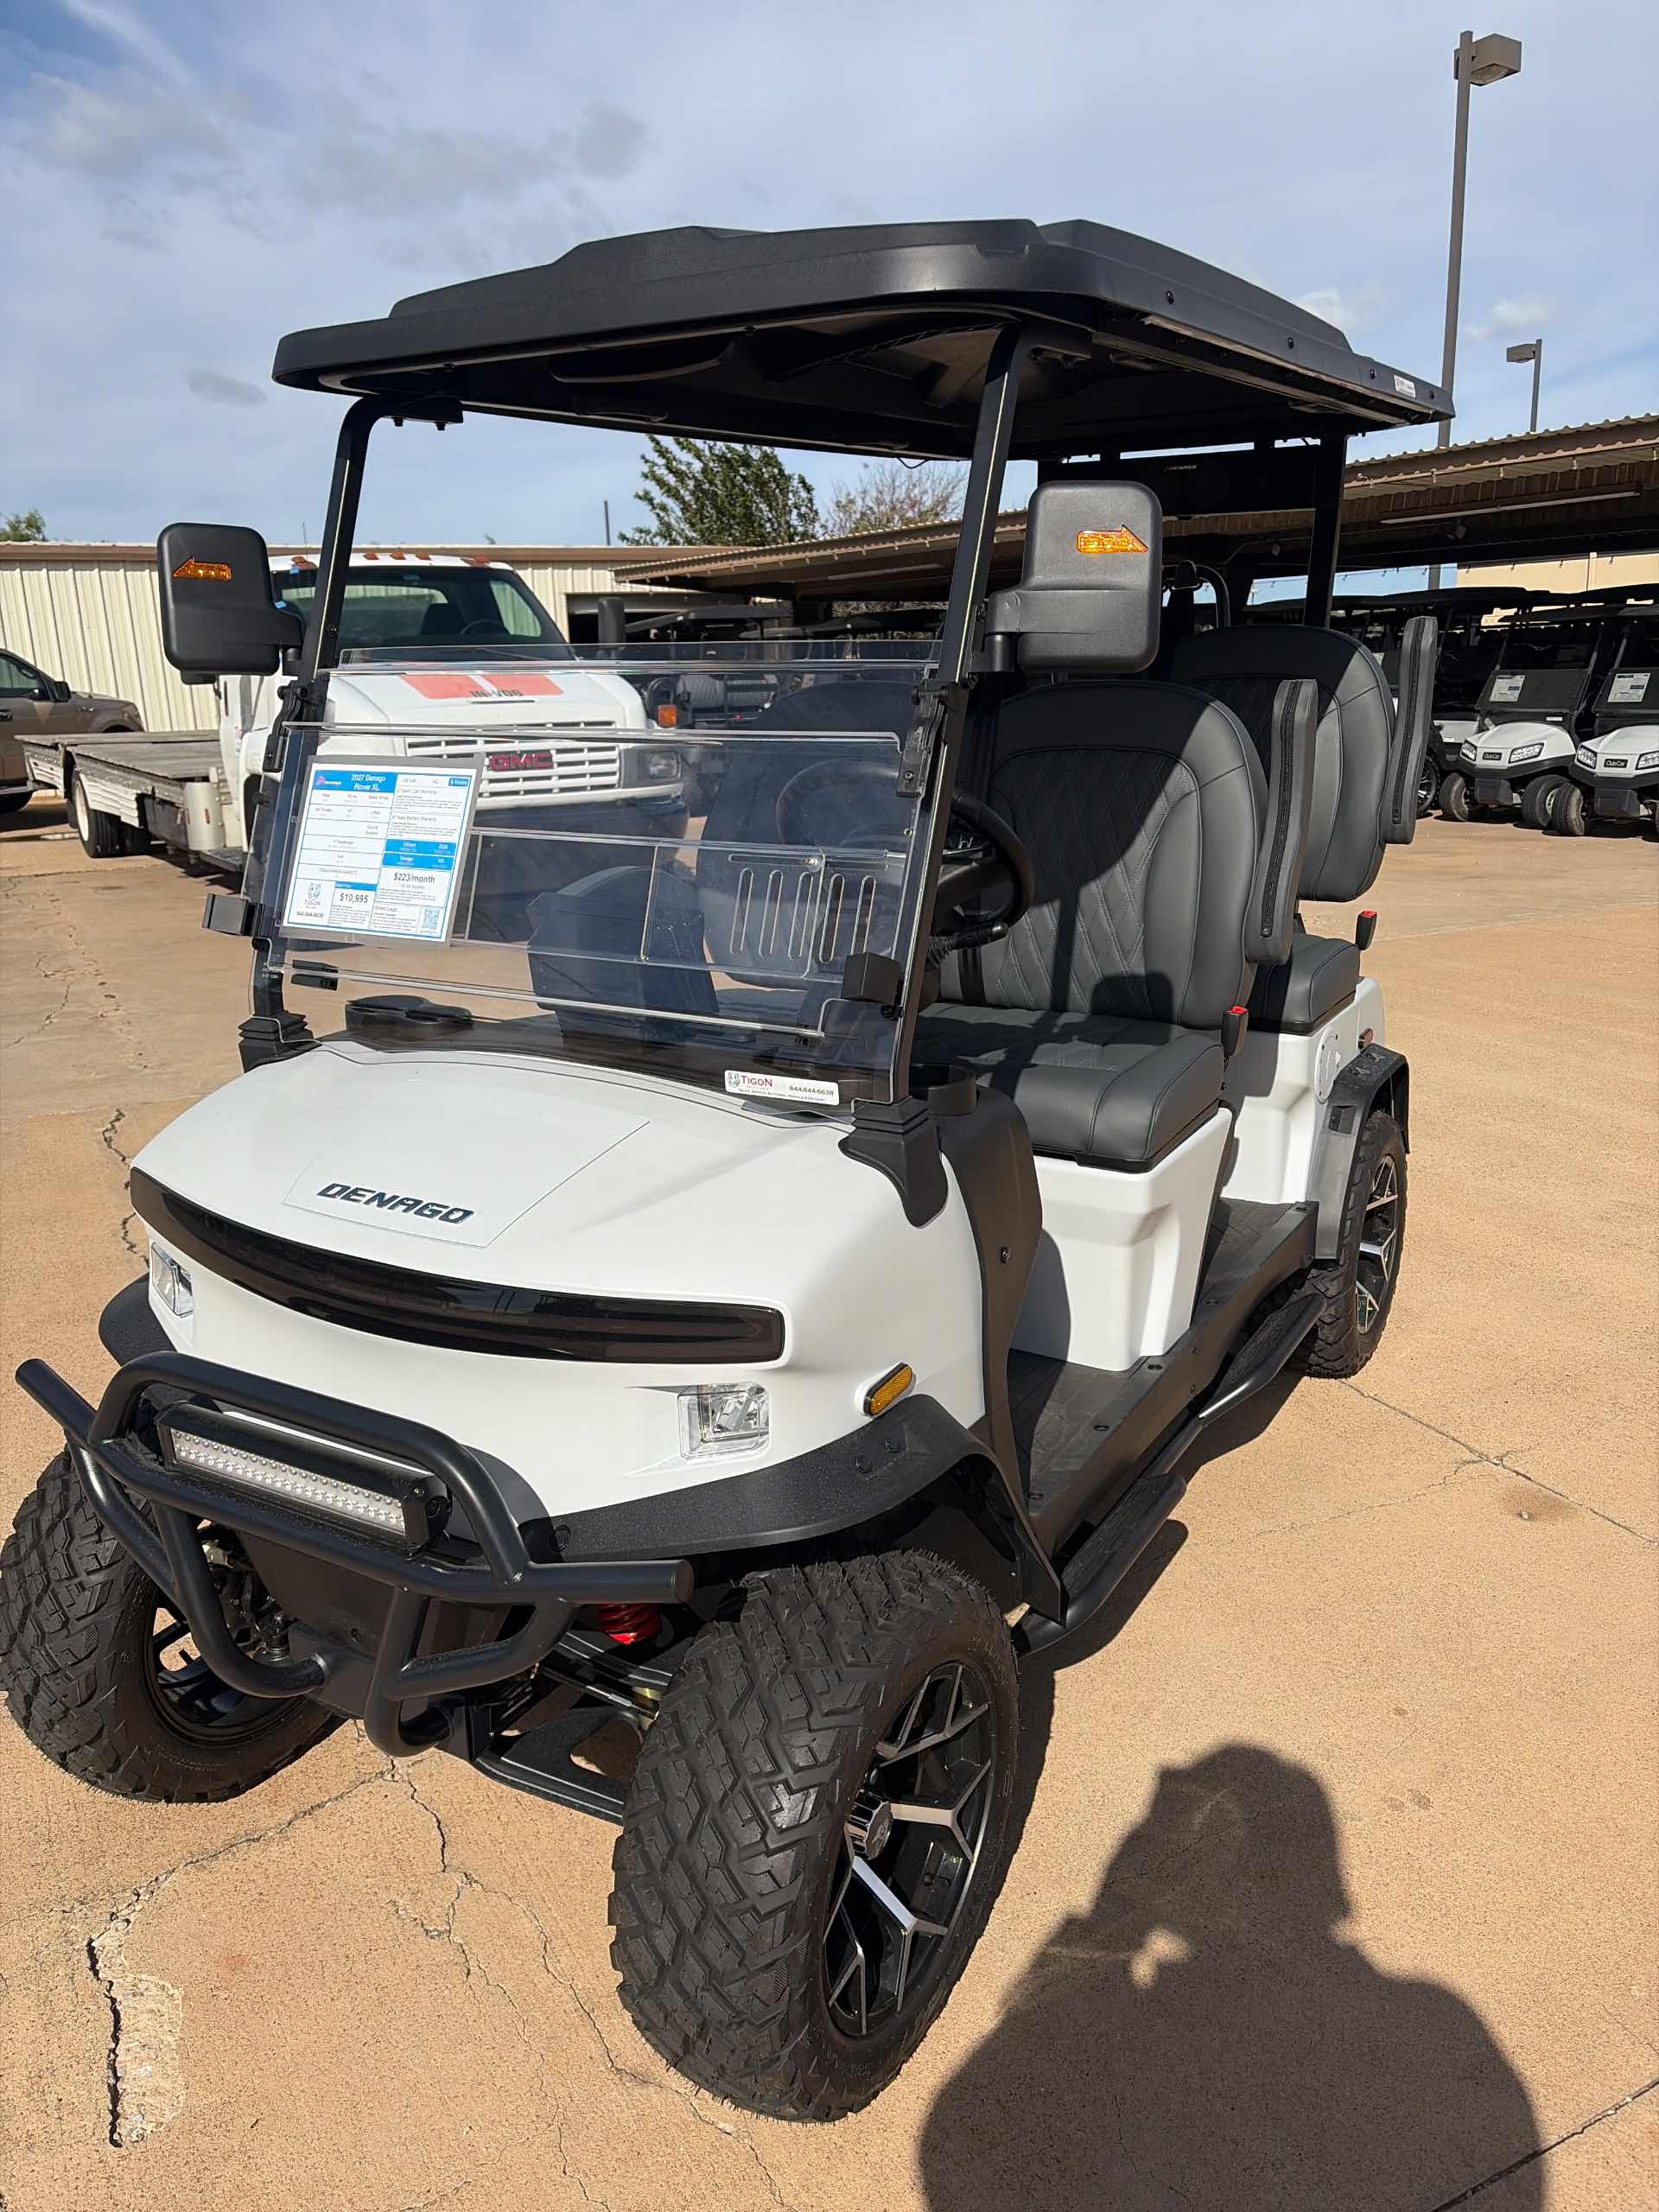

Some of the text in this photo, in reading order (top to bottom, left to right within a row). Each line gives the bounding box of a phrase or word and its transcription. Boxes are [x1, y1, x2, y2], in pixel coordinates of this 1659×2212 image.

[488, 751, 553, 772] GMC
[365, 774, 387, 783] Denago
[394, 872, 435, 884] $223/month
[340, 893, 369, 904] $10,995
[316, 1182, 475, 1224] DENAGO
